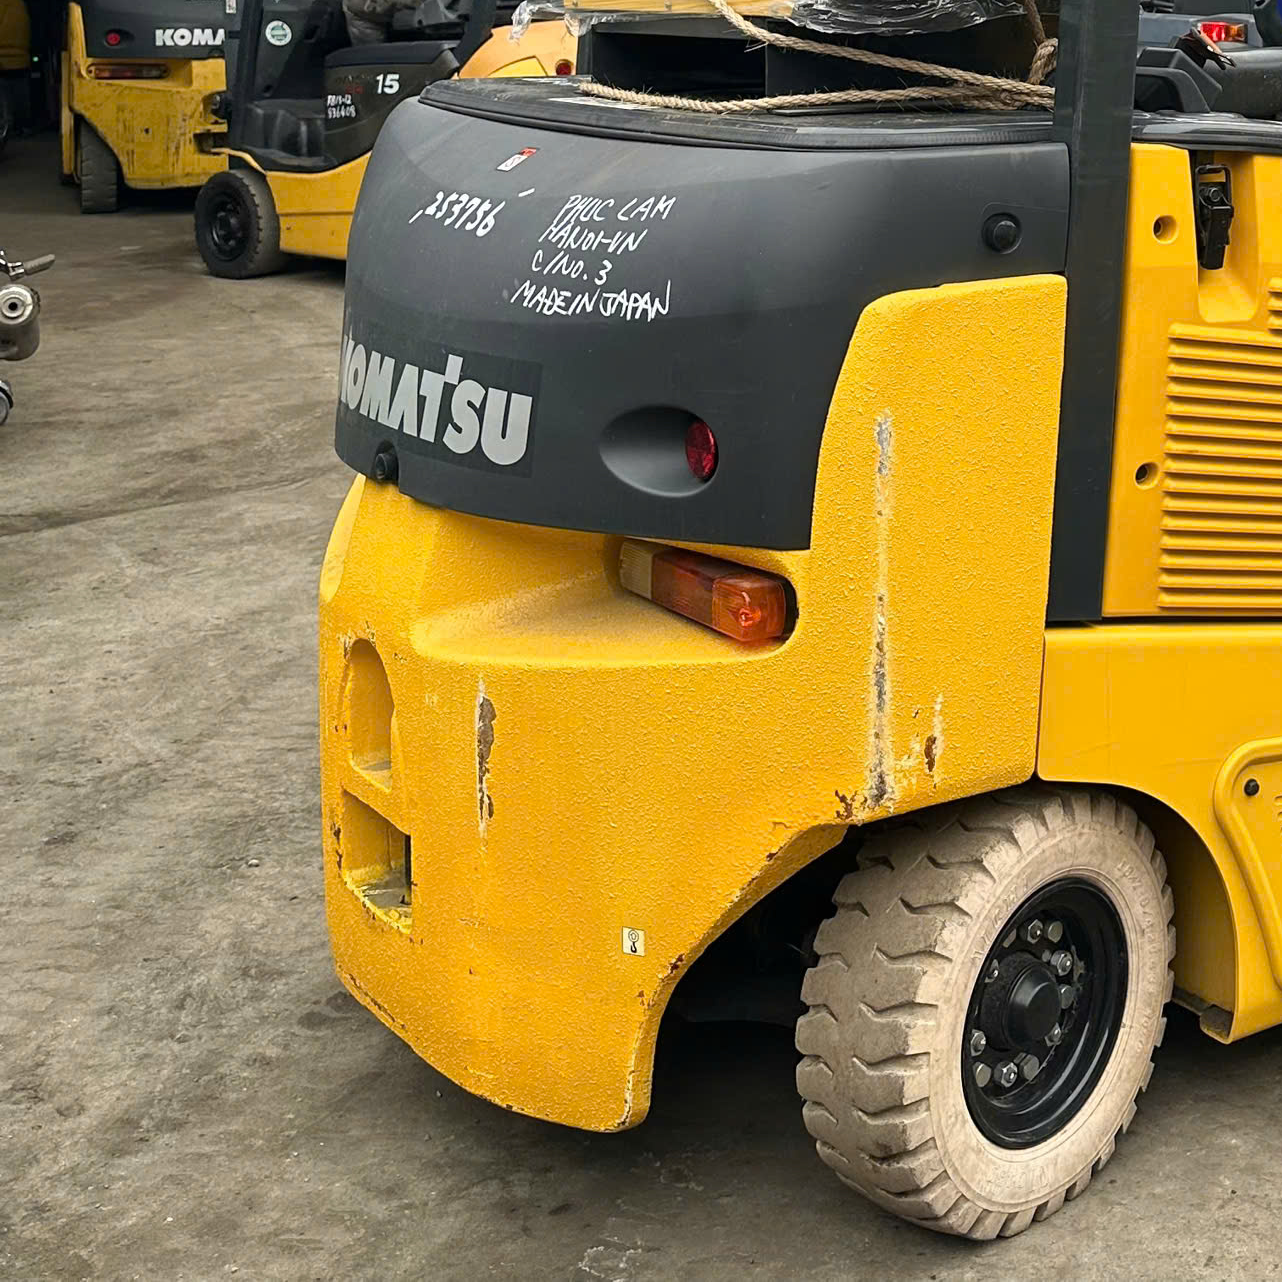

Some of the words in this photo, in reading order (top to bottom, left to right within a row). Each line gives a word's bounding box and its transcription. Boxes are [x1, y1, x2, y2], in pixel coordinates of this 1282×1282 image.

[154, 28, 226, 47] KOMA
[376, 72, 401, 95] 15
[552, 194, 616, 225] PHUC
[617, 194, 677, 222] LAM
[594, 259, 613, 286] 3
[599, 279, 672, 323] JAPAN
[341, 332, 533, 466] KOMATSU
